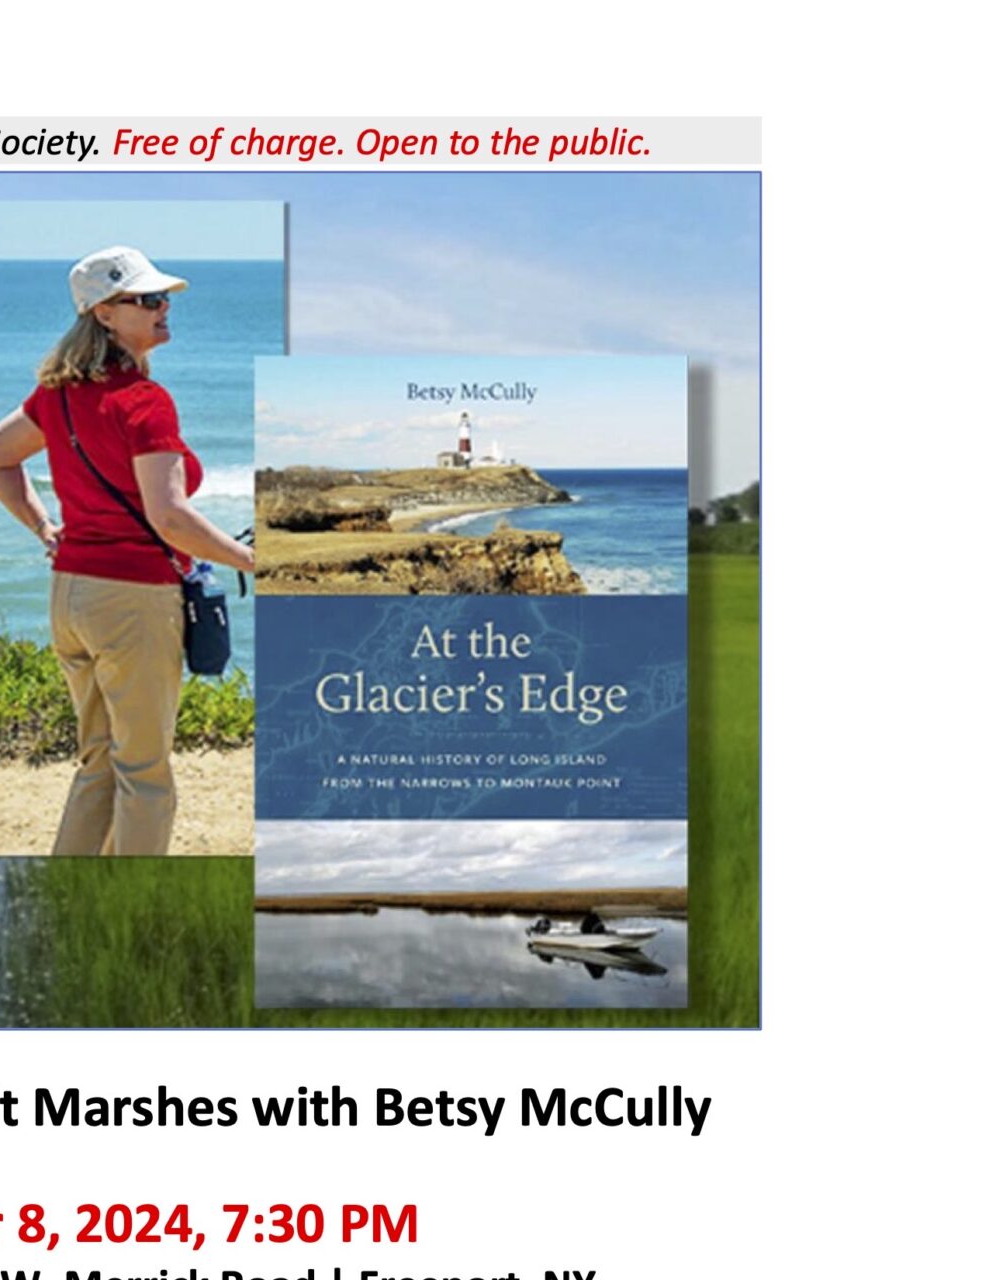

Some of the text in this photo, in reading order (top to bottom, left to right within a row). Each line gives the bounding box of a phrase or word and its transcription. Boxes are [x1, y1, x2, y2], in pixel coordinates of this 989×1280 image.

[114, 129, 179, 155] Free
[189, 127, 225, 162] of
[230, 127, 343, 162] charge.
[357, 129, 437, 162] Open
[450, 131, 479, 155] to
[491, 127, 539, 155] the
[548, 127, 649, 162] public.
[407, 382, 537, 404] Betsy McCully
[411, 622, 532, 659] At the
[315, 670, 628, 724] Glacier’s Edge
[337, 754, 607, 766] A NATURAL HISTORY OF LONG ISLAND
[322, 777, 622, 789] FROM THE NARROWS TO MONTAUK POINT
[35, 1085, 238, 1127] Marshes
[252, 1085, 357, 1127] with
[376, 1088, 505, 1136] Betsy
[522, 1085, 712, 1136] McCully
[18, 1204, 59, 1251] 8,
[76, 1204, 205, 1251] 2024,
[223, 1204, 324, 1243] 7:30
[342, 1204, 417, 1243] PM
